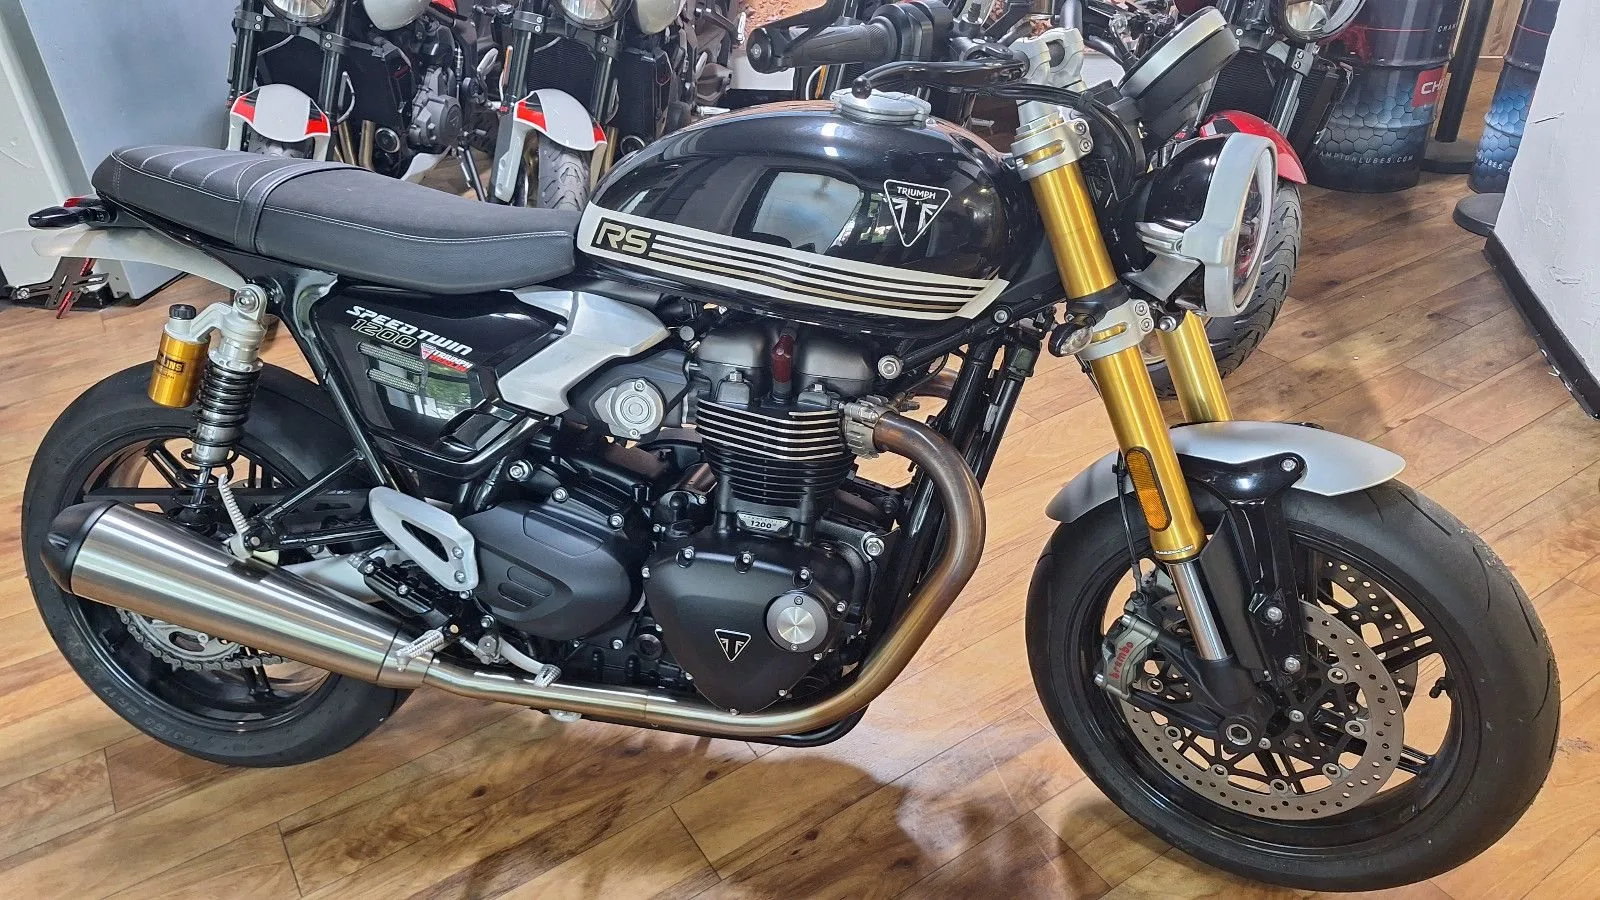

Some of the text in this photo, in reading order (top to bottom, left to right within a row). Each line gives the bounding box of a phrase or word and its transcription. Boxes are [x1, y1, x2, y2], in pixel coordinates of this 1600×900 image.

[896, 186, 936, 200] TRIUMPH
[595, 221, 652, 255] RS
[346, 305, 473, 356] SPEED TWIN
[350, 318, 418, 349] 1200
[750, 520, 772, 529] 1200
